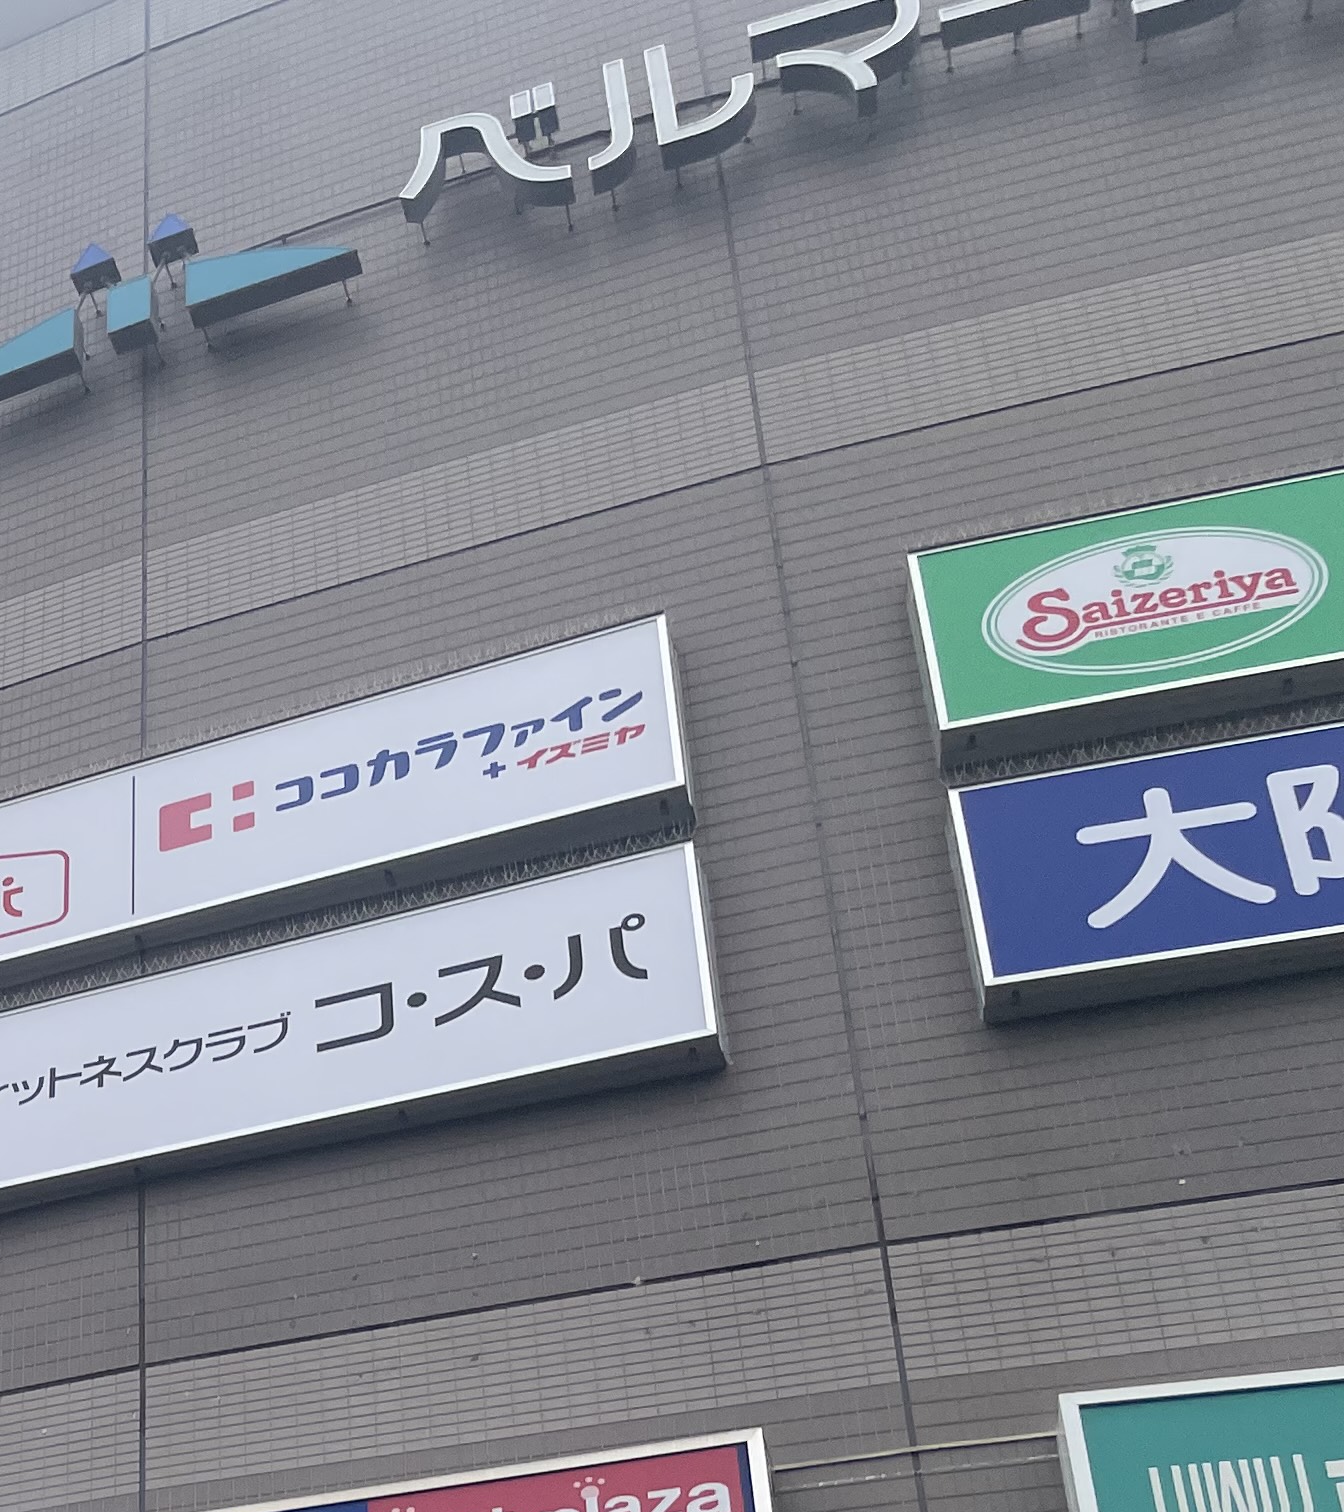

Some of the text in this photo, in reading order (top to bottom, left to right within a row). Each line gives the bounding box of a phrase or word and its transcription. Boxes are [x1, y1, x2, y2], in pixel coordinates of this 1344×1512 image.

[1022, 567, 1297, 643] Saizeriya
[1094, 615, 1190, 639] RISTORANTE
[275, 688, 644, 812] ココカラファイン
[315, 913, 649, 1052] コ・ス・パ
